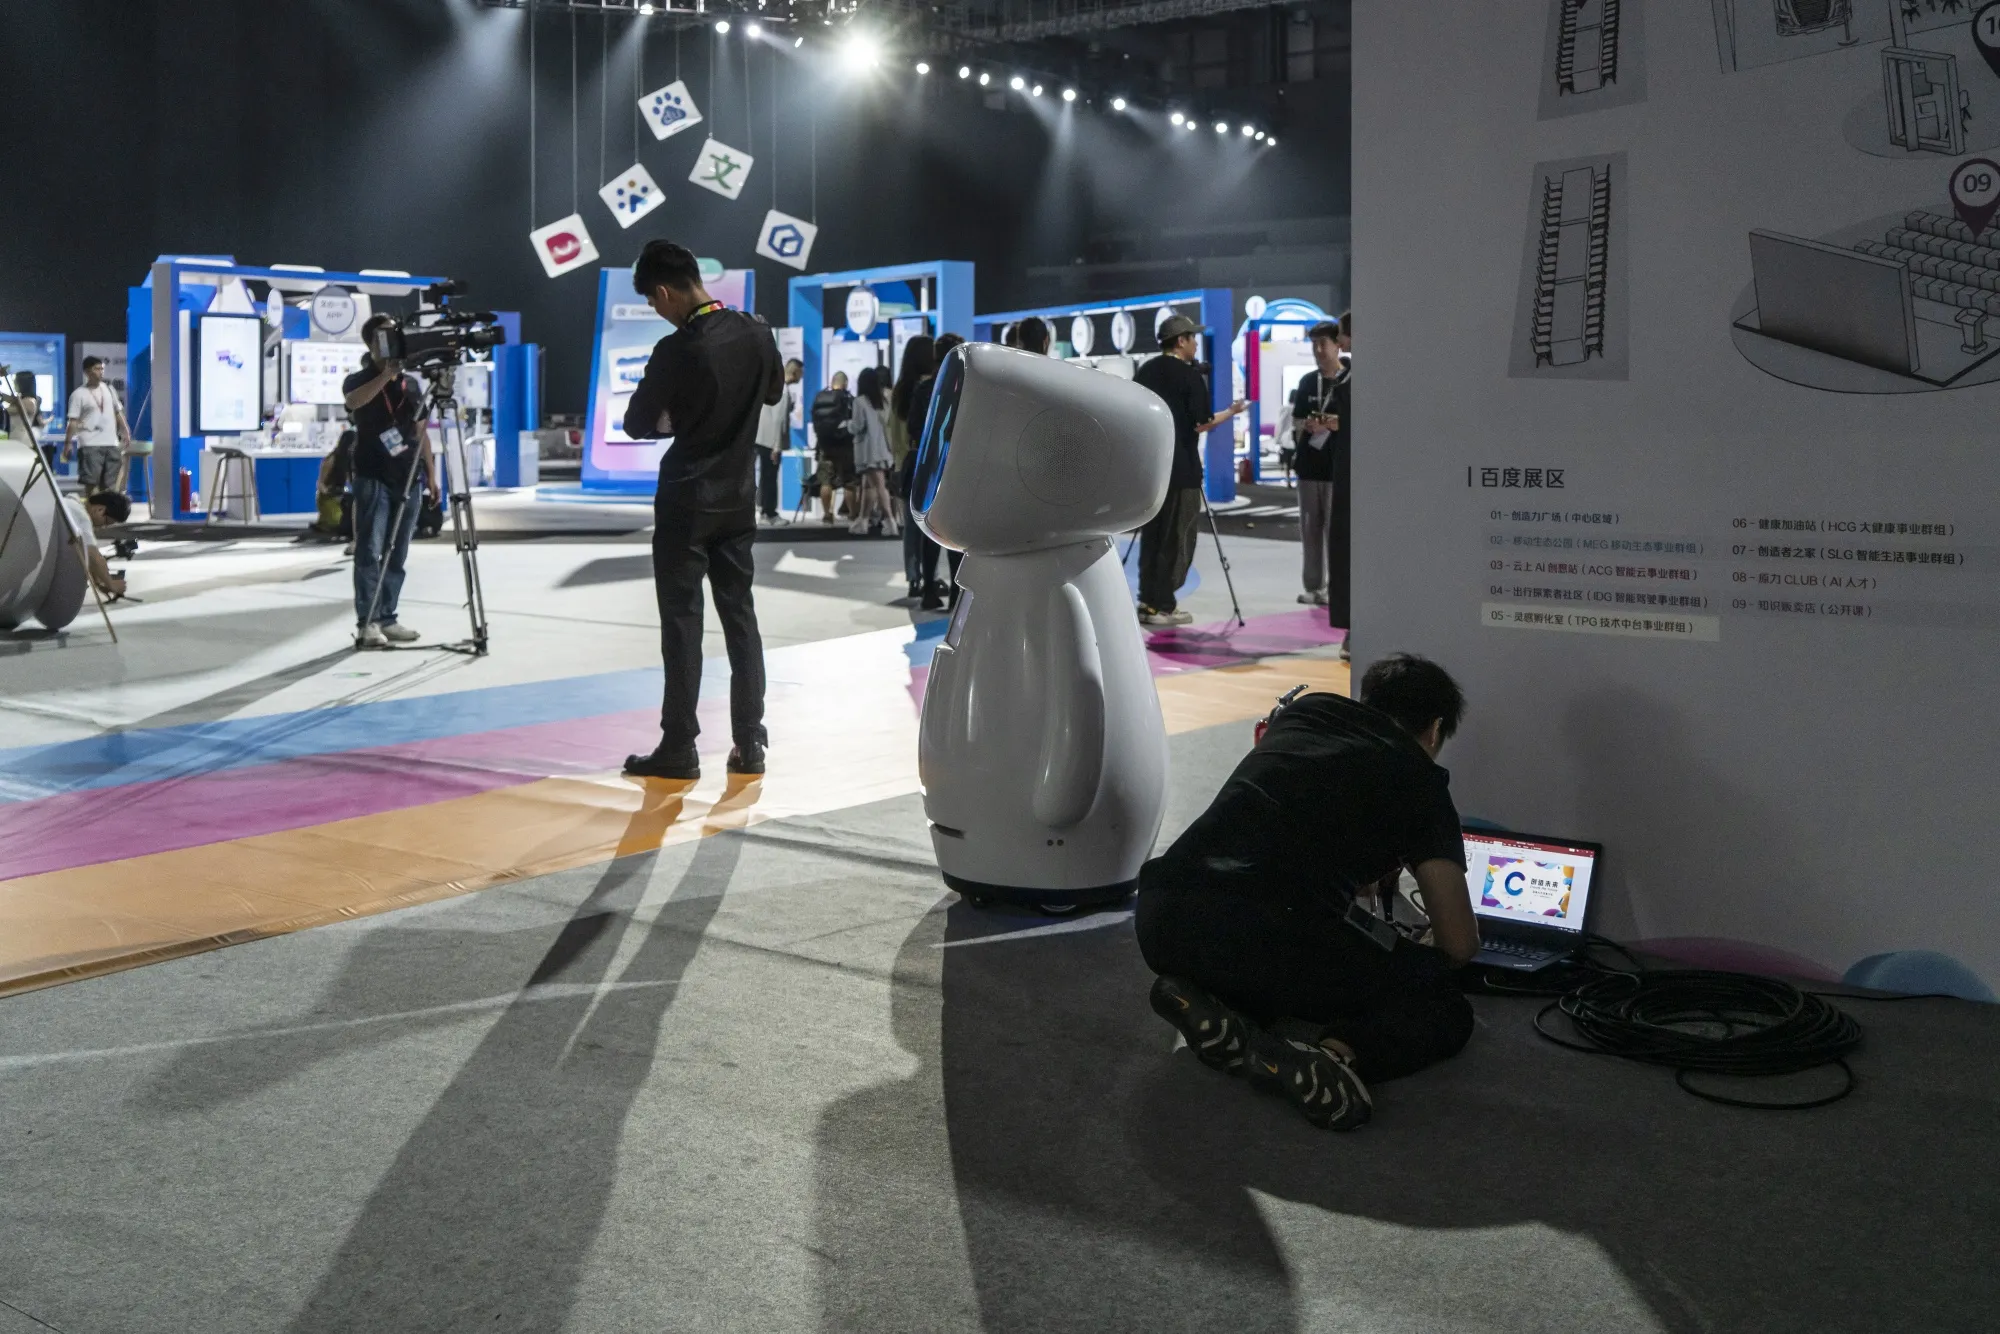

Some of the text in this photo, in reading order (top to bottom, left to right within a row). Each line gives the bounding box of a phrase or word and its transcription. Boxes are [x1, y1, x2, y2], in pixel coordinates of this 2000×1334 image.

[1985, 16, 2000, 34] 1
[700, 153, 741, 190] 文
[1963, 174, 1992, 193] 09
[1481, 467, 1565, 488] 百度展区
[1530, 878, 1558, 888] 创造未来
